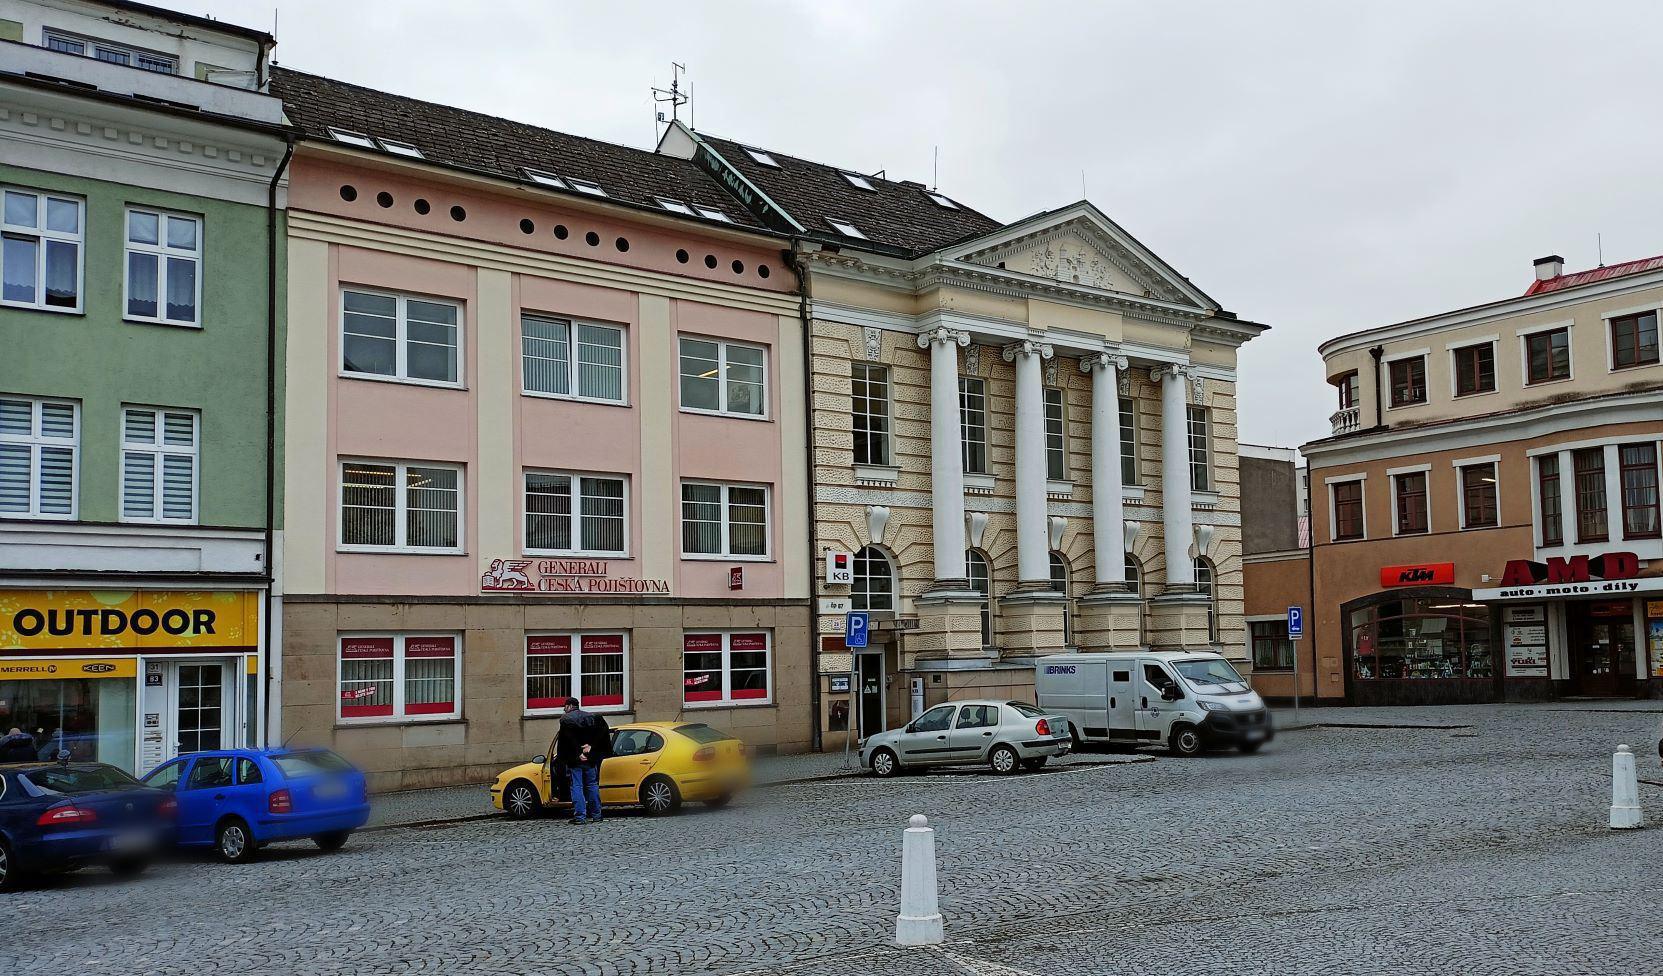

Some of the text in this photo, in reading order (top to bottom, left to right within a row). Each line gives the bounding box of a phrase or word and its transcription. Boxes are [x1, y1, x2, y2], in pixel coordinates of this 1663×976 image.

[538, 560, 608, 575] GENERALI
[1399, 568, 1434, 582] KTM
[1500, 552, 1639, 587] AMD
[833, 572, 849, 580] KB
[588, 577, 670, 592] POJIŠŤOVNA
[1500, 582, 1638, 597] auto moto díly
[13, 608, 217, 636] OUTDOOR
[1291, 610, 1299, 625] P
[851, 617, 864, 636] P
[1, 665, 47, 673] MERRELL
[83, 663, 115, 672] KEEN
[1049, 665, 1076, 674] BRINKS
